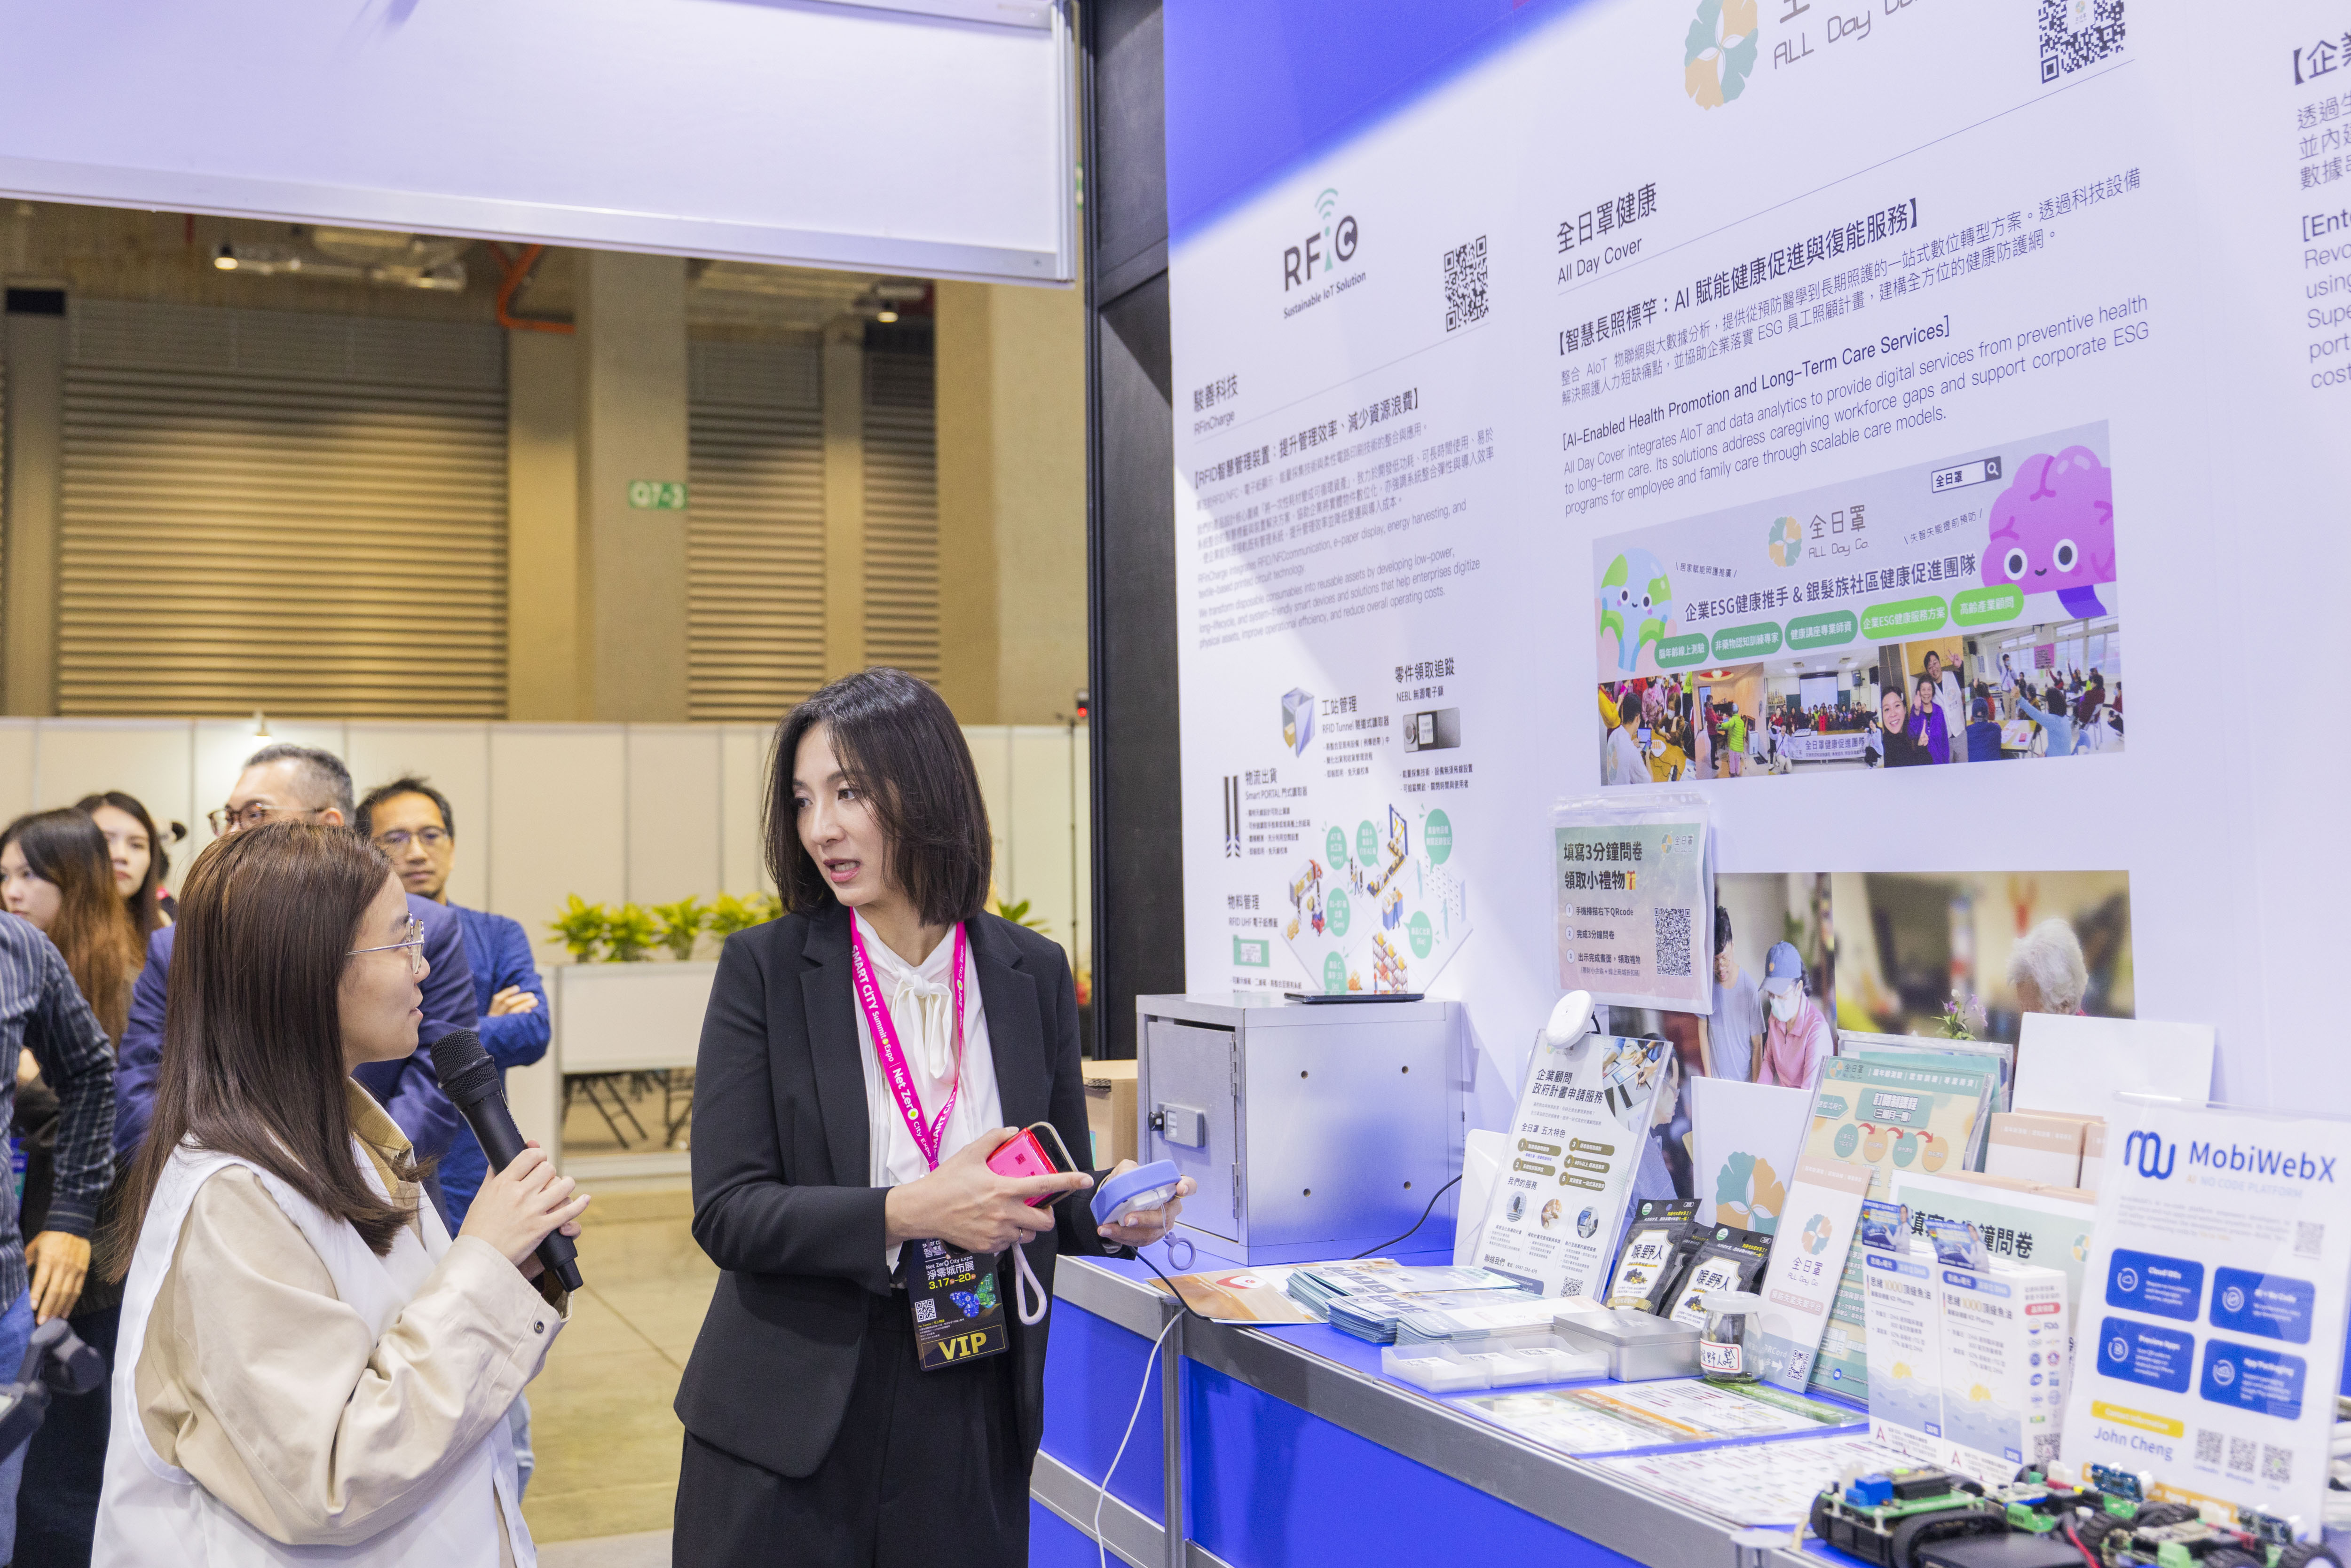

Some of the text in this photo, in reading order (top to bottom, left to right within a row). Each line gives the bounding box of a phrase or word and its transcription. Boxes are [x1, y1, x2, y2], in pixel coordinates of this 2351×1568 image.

[1775, 33, 1814, 70] ALL
[1827, 10, 1871, 43] Day
[1557, 182, 1657, 254] 全日罩健康
[1558, 238, 1642, 284] All Day Cover
[1284, 272, 1366, 319] Sustainable IoT Solution
[1562, 229, 2055, 406] 解決照護人力短缺痛點，並協助企業落實 ESG 員工照顧計畫，建構全方位的健康防護網。
[1563, 315, 1949, 451] [AI-Enabled Health Promotion and Long-Term Care Services]
[1564, 295, 2147, 475] All Day Cover integrates AIoT and data analytics to provide digital services from preventive health
[1565, 321, 2148, 494] to long-term care. Its solutions address caregiving workforce gaps and support corporate ESG
[1565, 406, 1946, 517] programs for employee and family care through scalable care models.
[1936, 471, 1963, 488] 全日罩
[1387, 498, 1466, 532] energy harvesting, and
[1809, 504, 1865, 540] 全日罩
[1910, 511, 1976, 544] 失智失能提前預防
[1809, 543, 1850, 558] ALL Day
[1680, 562, 1732, 578] 居家賦能照護推廣
[1685, 553, 1976, 622] 企業ESG健康推手 & 銀髮族社區健康促進團隊
[1960, 595, 2014, 615] 高齡產業顧問
[1863, 607, 1945, 630] 企業ESG健康服務方案
[1791, 621, 1852, 640] 健康講座專業師資
[1659, 643, 1705, 659] 腦年齡線上測驗
[1715, 632, 1779, 651] 非藥物認知訓練專家
[1395, 657, 1455, 684] 零件領取追蹤
[1322, 695, 1357, 716] 工站管理
[1323, 720, 1354, 734] RFID Tunnel
[1674, 835, 1694, 846] 全日罩
[1563, 841, 1643, 862] 填寫3分鐘問卷
[1564, 870, 1625, 890] 領取小禮物
[1576, 906, 1634, 917] 手機掃描右下QRcode
[1577, 930, 1615, 940] 完成3分鐘問卷
[1578, 952, 1641, 965] 出示完成畫面，領取禮物
[852, 945, 869, 984] SMART
[872, 1011, 887, 1040] Summit
[884, 1044, 894, 1063] Expo
[1536, 1069, 1573, 1085] 企業顧問
[1844, 1064, 1864, 1074] 全日罩
[1532, 1082, 1604, 1104] 政府計畫申請服務
[892, 1068, 907, 1090] Net
[914, 1121, 923, 1137] City
[921, 1137, 931, 1158] Expo
[1521, 1123, 1565, 1138] 全日罩 五大特色
[2189, 1141, 2336, 1183] MobiWebX
[1508, 1176, 1538, 1190] 我們的服務
[2248, 1181, 2303, 1199] PLATFORM
[1910, 1210, 2033, 1259] 填鐘問卷
[927, 1261, 975, 1280] 淨零城市展
[1484, 1254, 1506, 1267] 聯絡我們
[1792, 1257, 1823, 1276] 全日罩
[929, 1277, 949, 1290] 3.17
[1788, 1272, 1809, 1286] ALL Day
[1771, 1292, 1822, 1314] 預防失能失智平台
[938, 1332, 987, 1360] VIP
[2094, 1427, 2174, 1461] John Cheng
